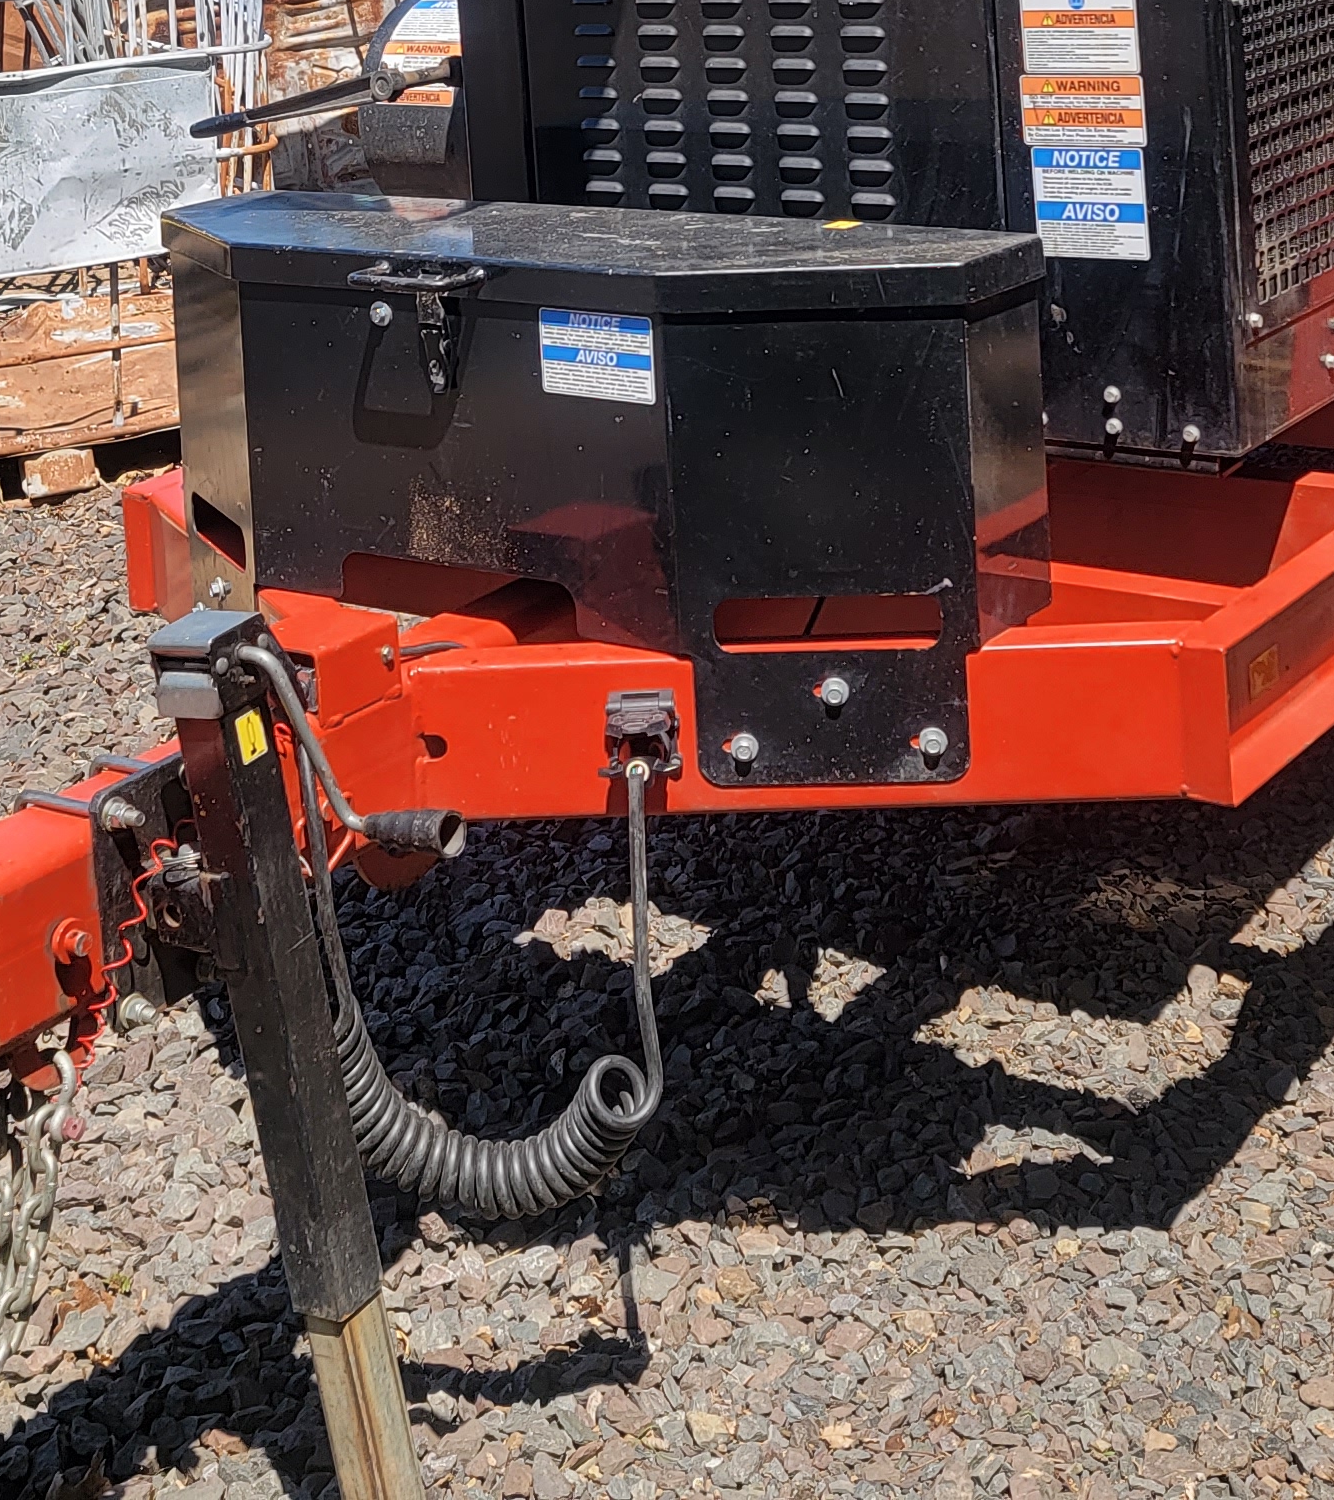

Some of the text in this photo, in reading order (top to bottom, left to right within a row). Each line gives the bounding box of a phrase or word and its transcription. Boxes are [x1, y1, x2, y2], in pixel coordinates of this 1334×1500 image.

[1055, 13, 1116, 25] ADVERTENCIA
[406, 45, 451, 54] WARNING
[1056, 80, 1121, 92] WARNING
[1057, 112, 1125, 125] ADVERTENCIA
[1052, 151, 1121, 167] NOTICE
[1062, 203, 1120, 221] AVISO
[568, 313, 621, 331] NOTICE
[575, 350, 617, 366] AVISO
